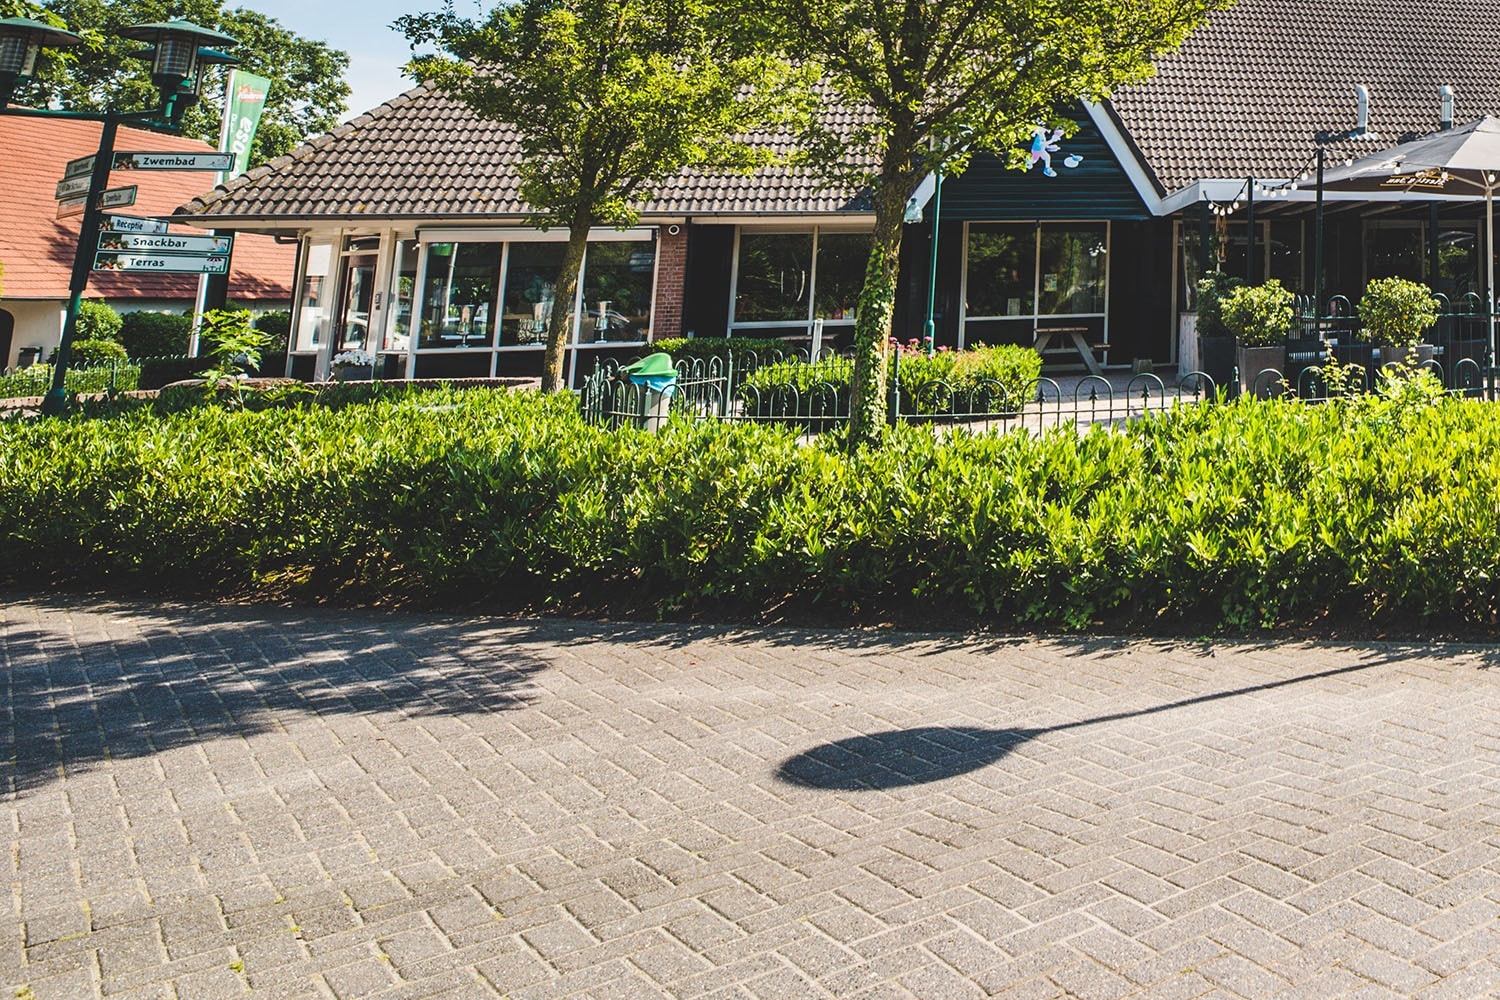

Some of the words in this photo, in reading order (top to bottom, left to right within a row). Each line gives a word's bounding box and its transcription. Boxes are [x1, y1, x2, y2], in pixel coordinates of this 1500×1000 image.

[143, 157, 196, 166] Zwembad
[116, 217, 144, 230] Receptie
[133, 237, 188, 248] Snackbar
[129, 257, 165, 267] Terras
